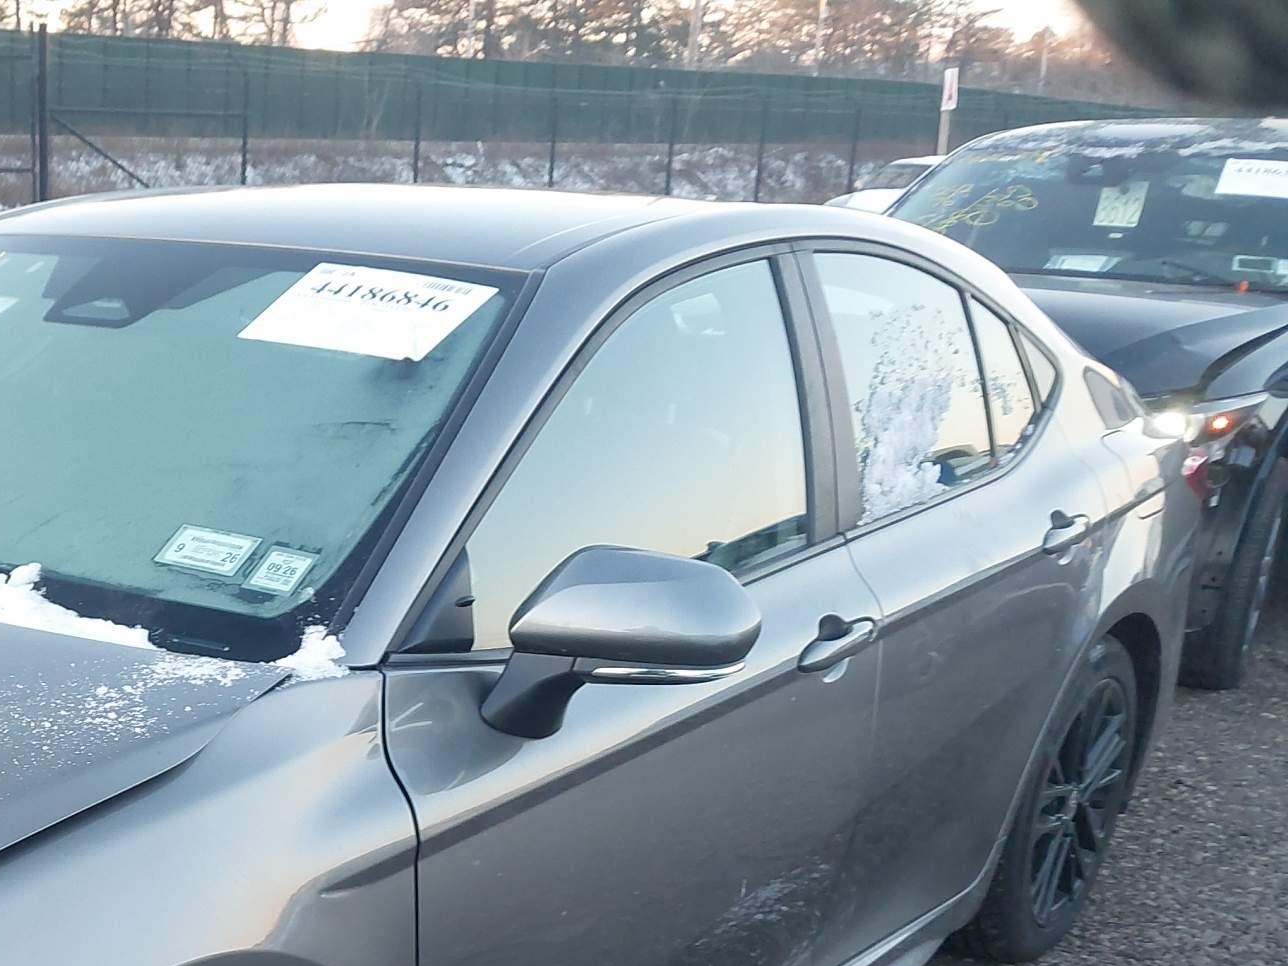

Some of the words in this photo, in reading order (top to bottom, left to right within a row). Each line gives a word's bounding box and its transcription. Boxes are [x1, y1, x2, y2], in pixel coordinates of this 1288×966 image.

[311, 280, 450, 313] 44186846
[174, 542, 186, 553] 9
[221, 551, 240, 564] 26
[266, 562, 282, 573] 09
[282, 565, 298, 576] 26
